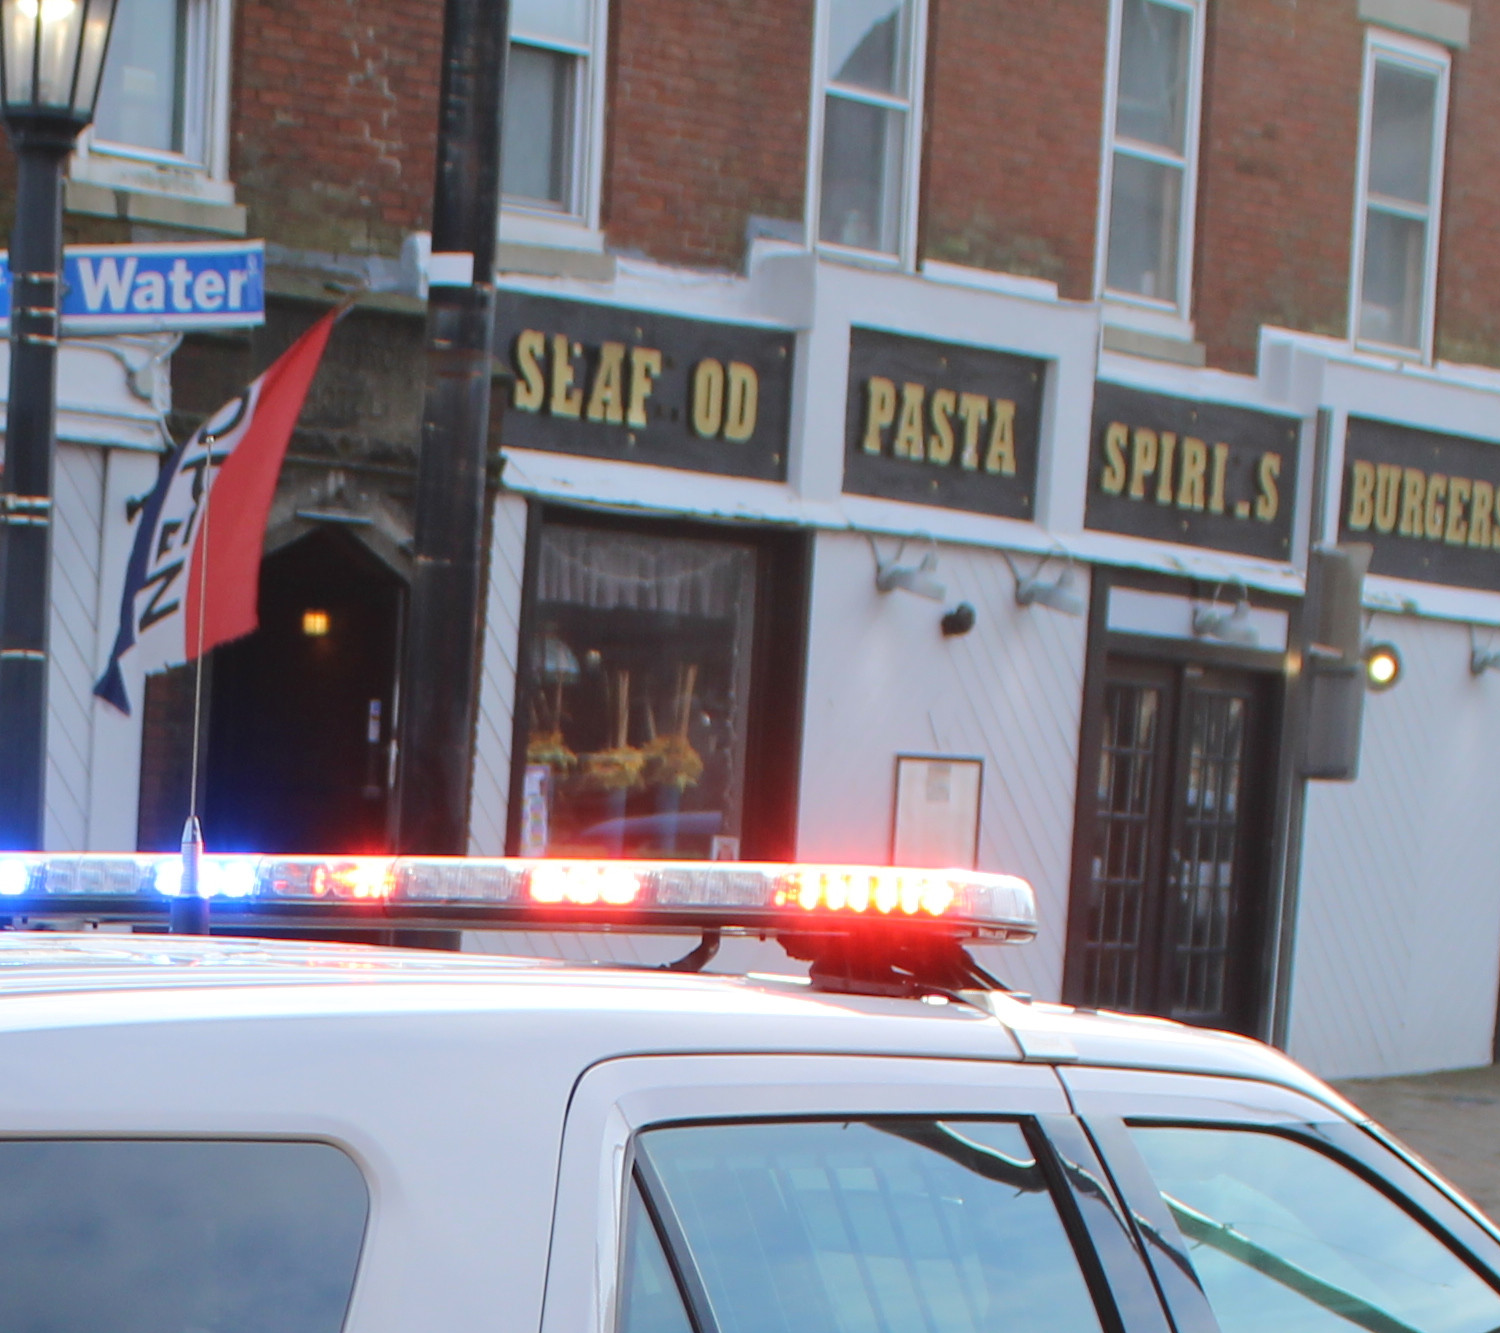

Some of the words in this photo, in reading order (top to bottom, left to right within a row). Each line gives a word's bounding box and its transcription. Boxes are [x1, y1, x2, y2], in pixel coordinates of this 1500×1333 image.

[78, 257, 248, 312] Water
[862, 375, 1017, 477] PASTA
[1101, 421, 1282, 525] SPIRIS
